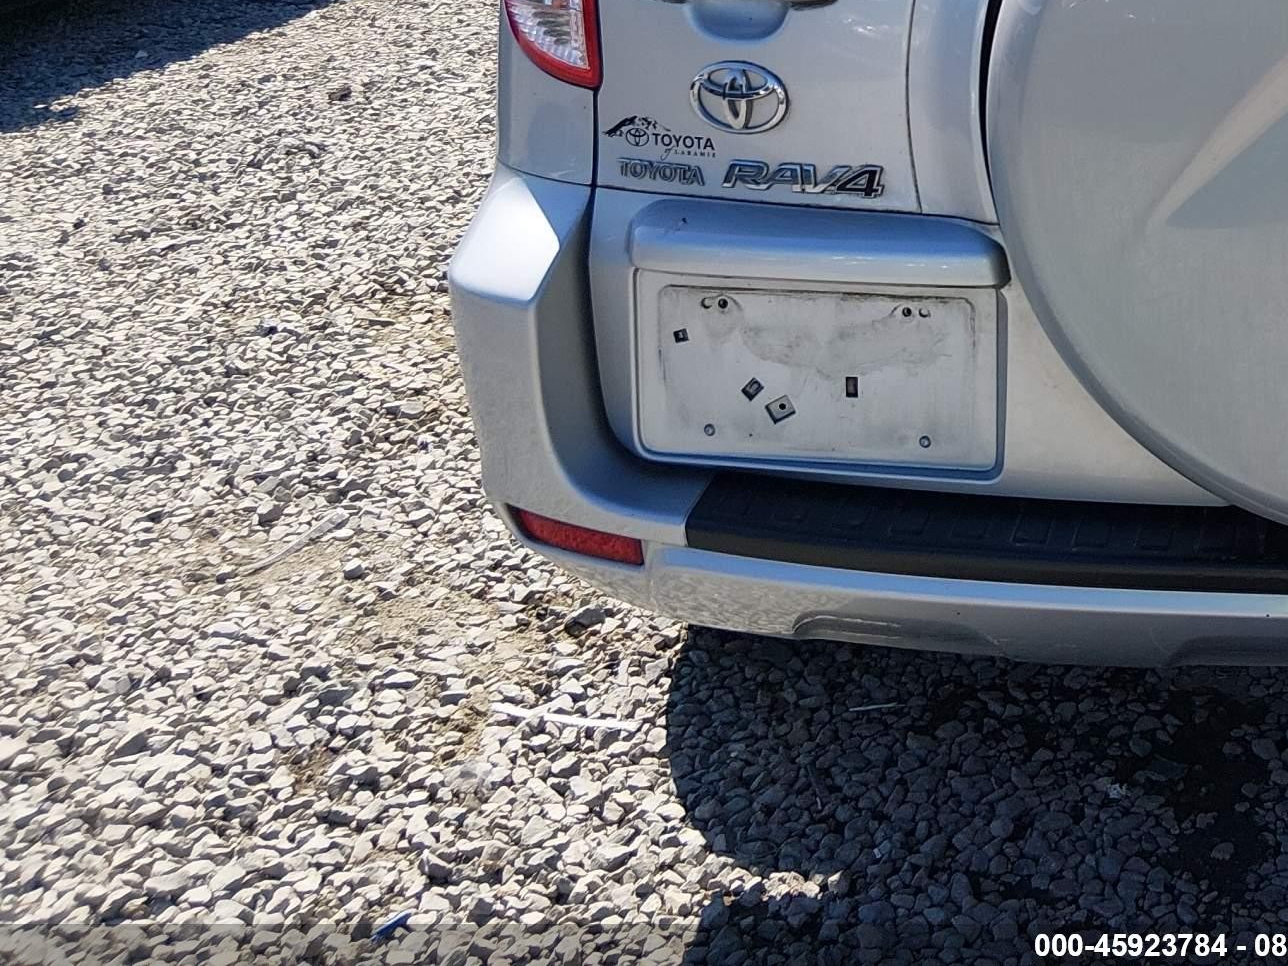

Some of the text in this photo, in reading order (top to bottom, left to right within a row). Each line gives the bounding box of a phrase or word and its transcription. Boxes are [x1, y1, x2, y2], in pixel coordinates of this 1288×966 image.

[651, 132, 716, 151] TOYOTA
[616, 157, 885, 199] TOYOTA RAV4
